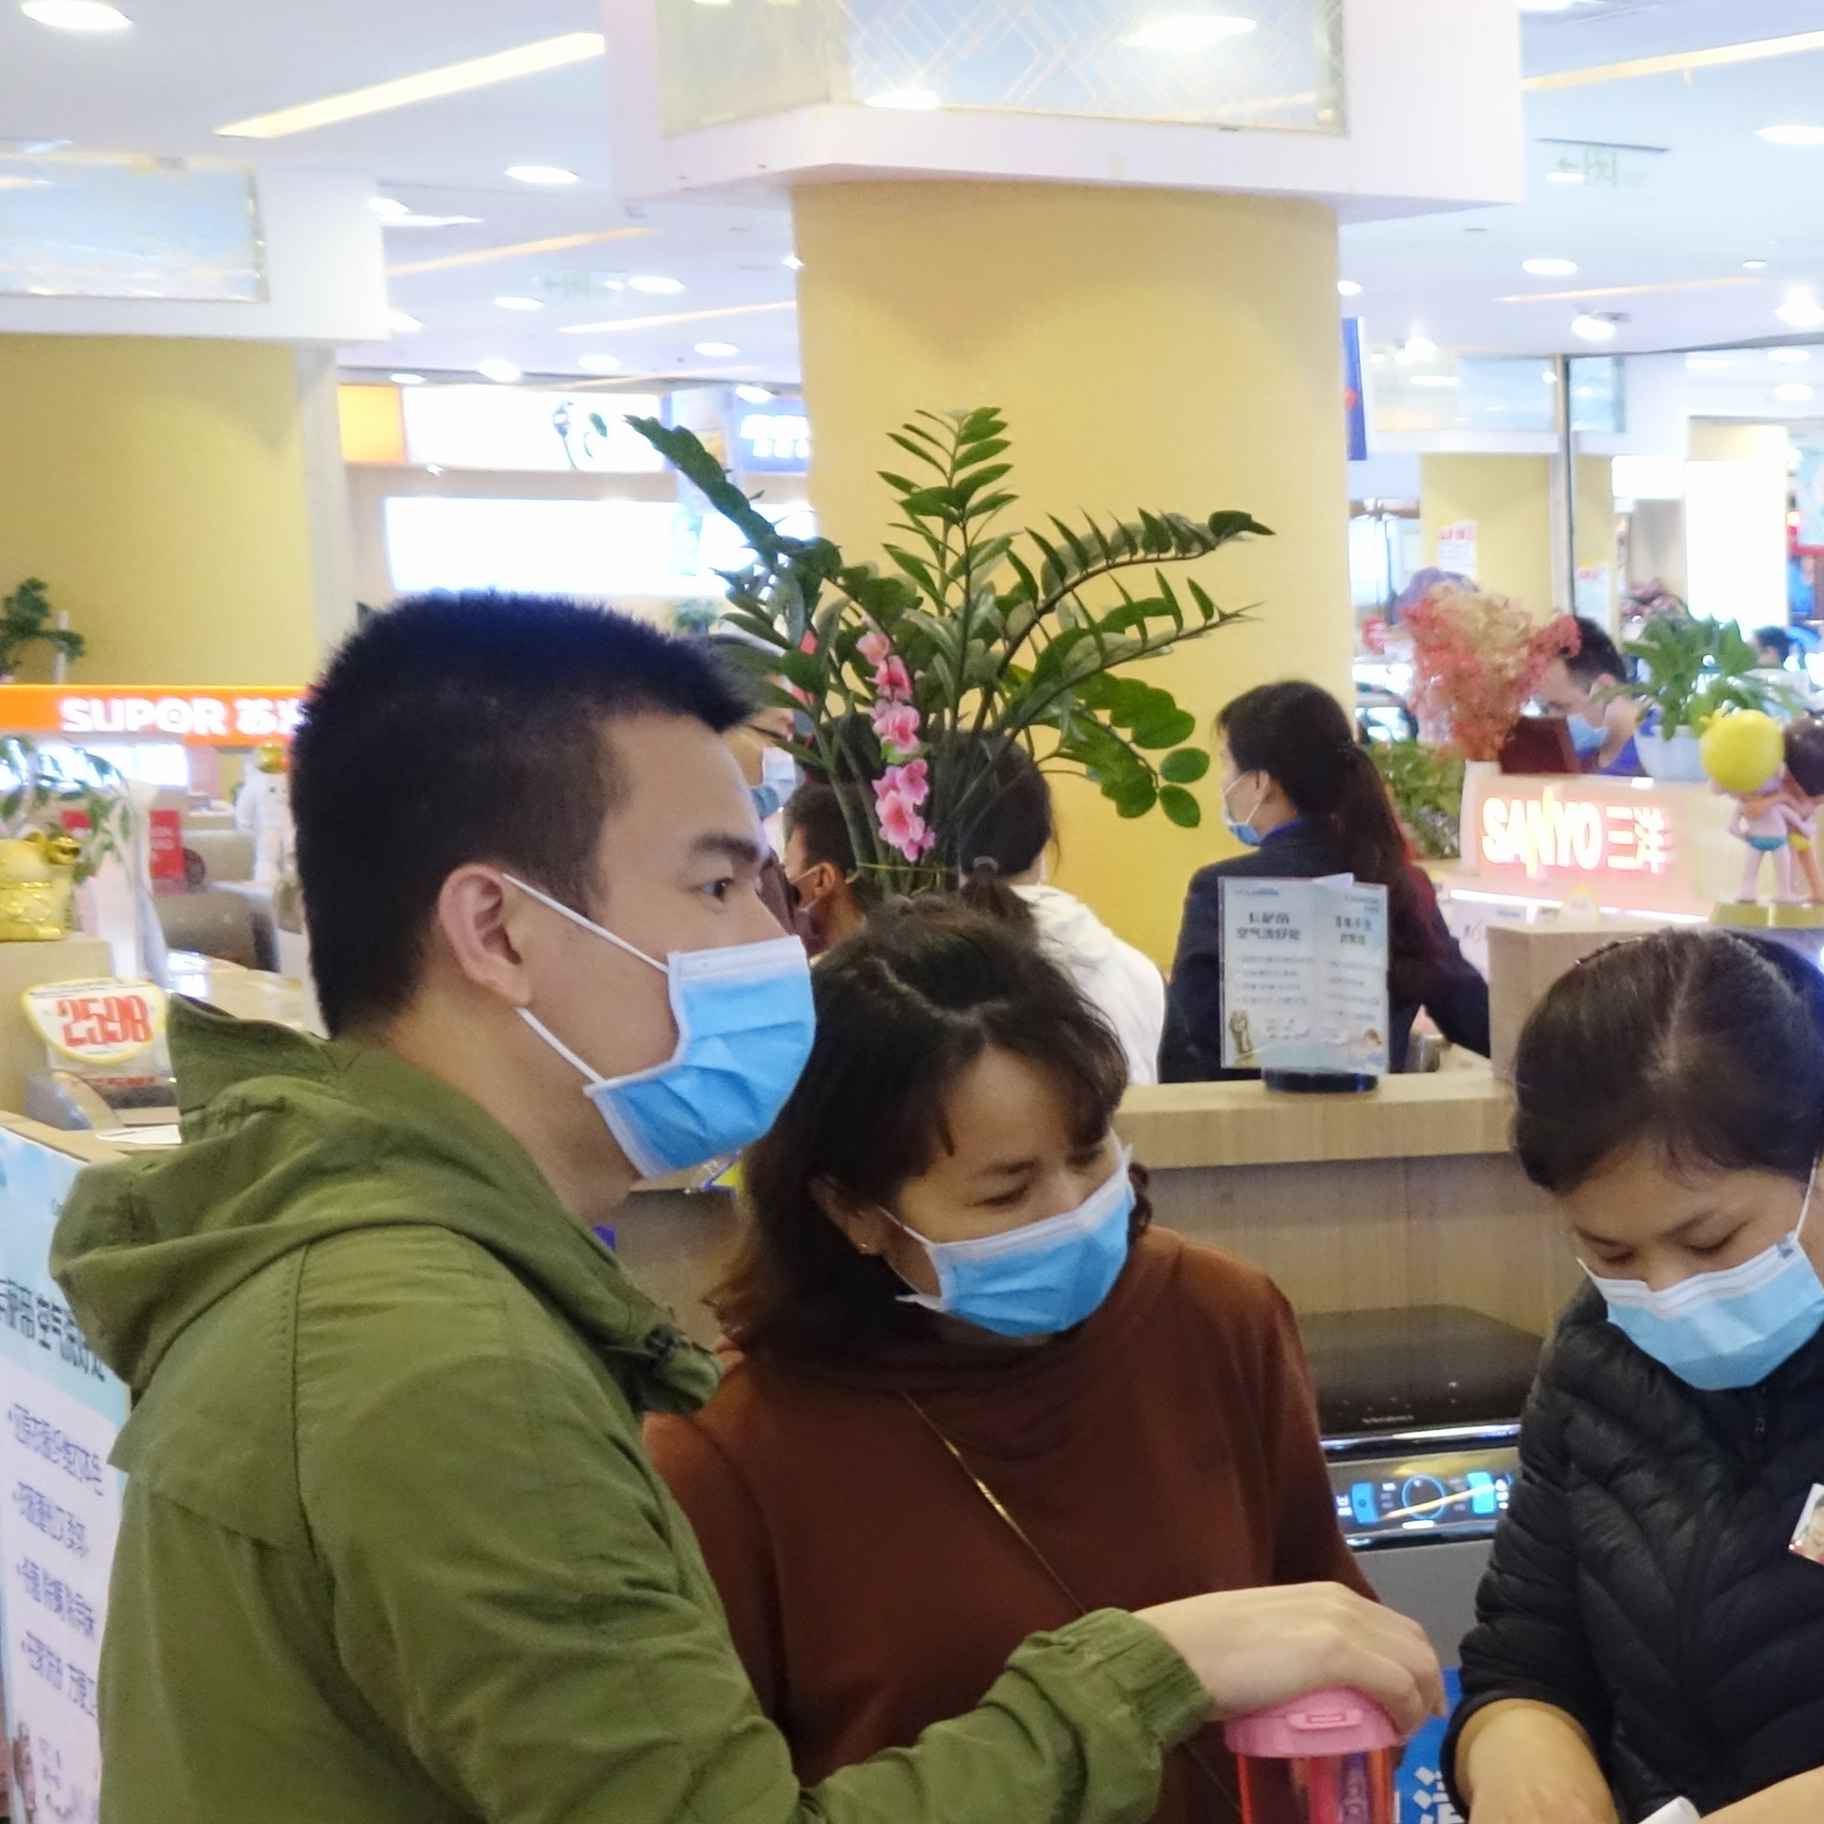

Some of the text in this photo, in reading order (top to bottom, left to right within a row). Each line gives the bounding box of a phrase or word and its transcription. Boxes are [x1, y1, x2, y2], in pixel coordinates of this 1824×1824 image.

[60, 696, 228, 736] SUPOR
[1481, 786, 1674, 878] SANYO 三洋
